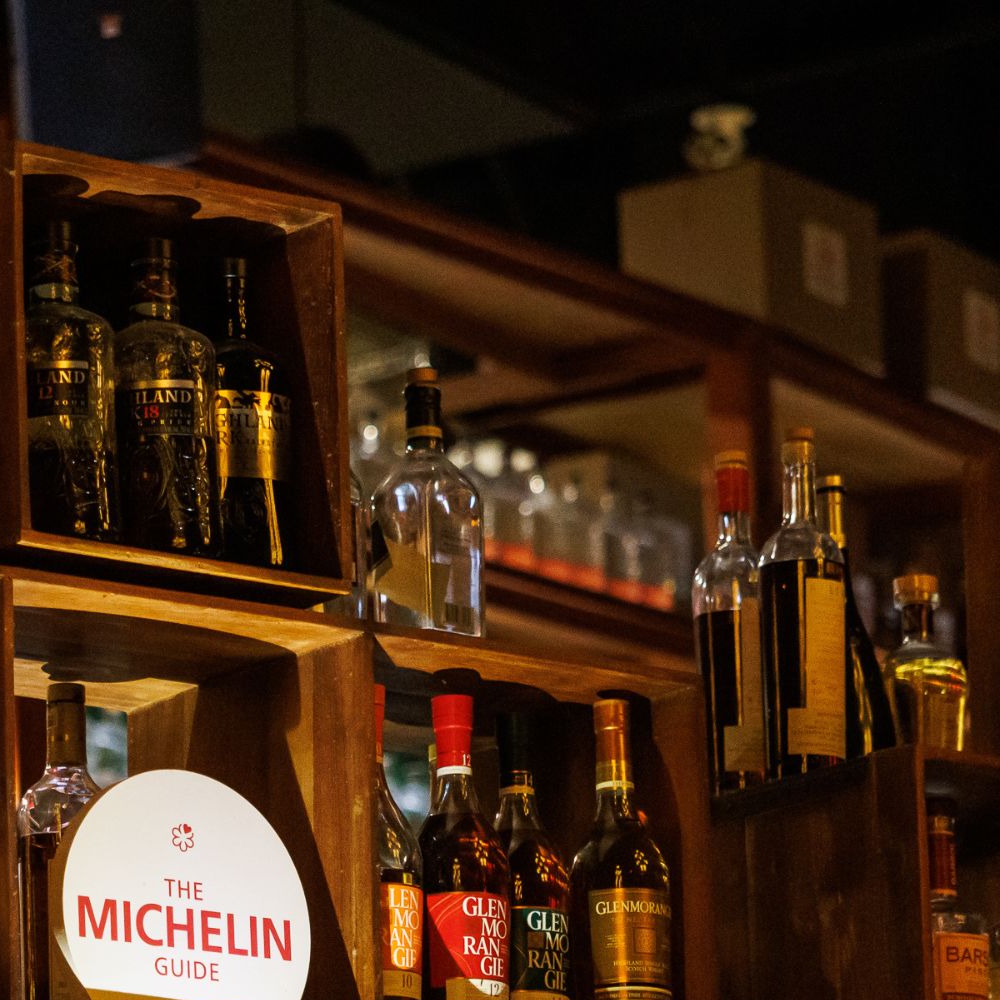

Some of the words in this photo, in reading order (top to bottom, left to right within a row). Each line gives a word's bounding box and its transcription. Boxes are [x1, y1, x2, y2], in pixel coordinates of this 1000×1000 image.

[143, 404, 161, 419] 18
[463, 753, 472, 767] 12
[164, 878, 204, 901] THE
[389, 887, 419, 910] LEN
[394, 908, 420, 930] MO
[462, 896, 507, 920] GLEN
[77, 895, 292, 962] MICHELIN
[481, 917, 508, 939] MO
[526, 910, 569, 934] GLEN
[462, 935, 500, 957] RAN
[545, 931, 570, 954] MO
[155, 956, 220, 982] GUIDE
[480, 956, 504, 977] GIE
[528, 949, 563, 971] RAN
[401, 974, 413, 988] 10
[490, 983, 500, 997] 12
[544, 969, 567, 991] GIE
